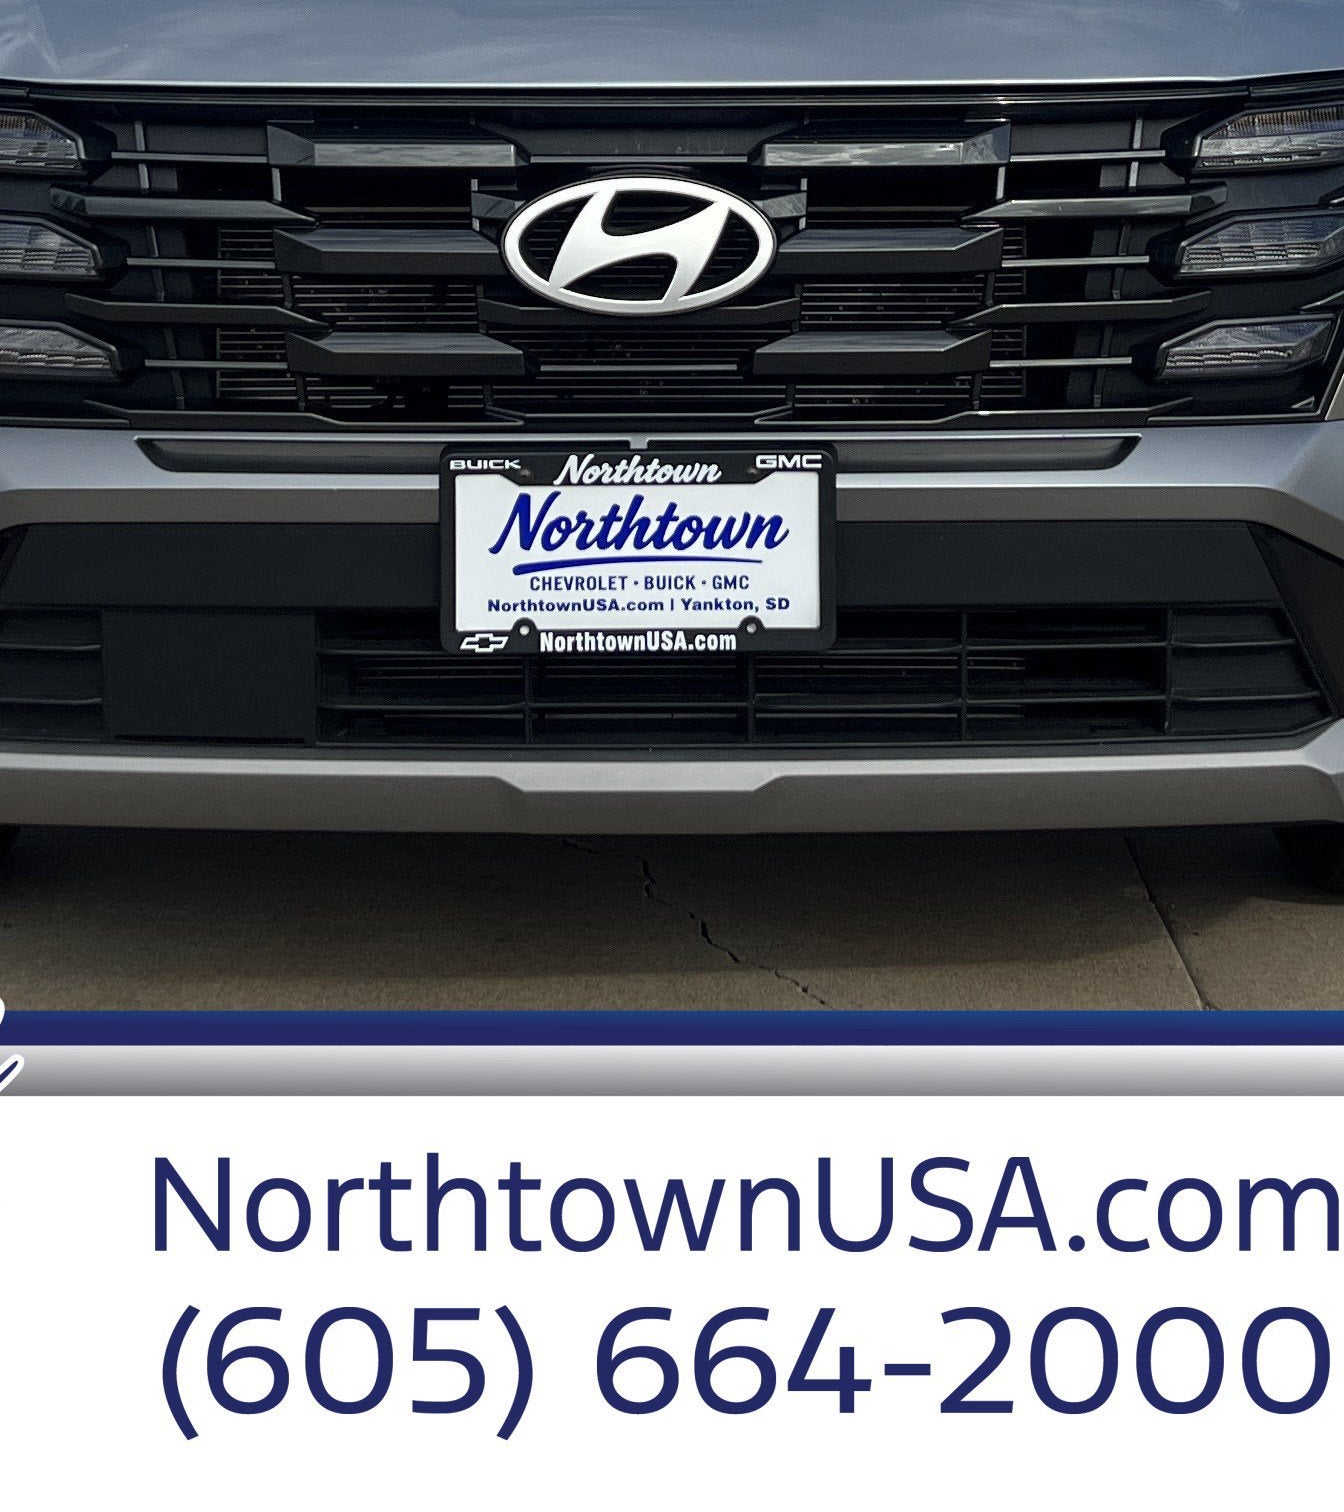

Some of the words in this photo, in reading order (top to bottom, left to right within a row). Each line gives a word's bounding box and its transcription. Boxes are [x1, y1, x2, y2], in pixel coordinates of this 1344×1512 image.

[449, 458, 522, 471] BUICK
[553, 453, 722, 486] Northtown
[755, 454, 823, 470] GMC
[488, 490, 790, 555] Northtown
[529, 575, 627, 592] CHEVROLET
[644, 575, 697, 590] BUICK
[712, 575, 751, 590] GMC
[487, 598, 664, 612] NorthtownUSA.com
[681, 597, 760, 613] Yankton,
[765, 595, 791, 611] SD
[539, 628, 738, 653] NorthtownUSA.com
